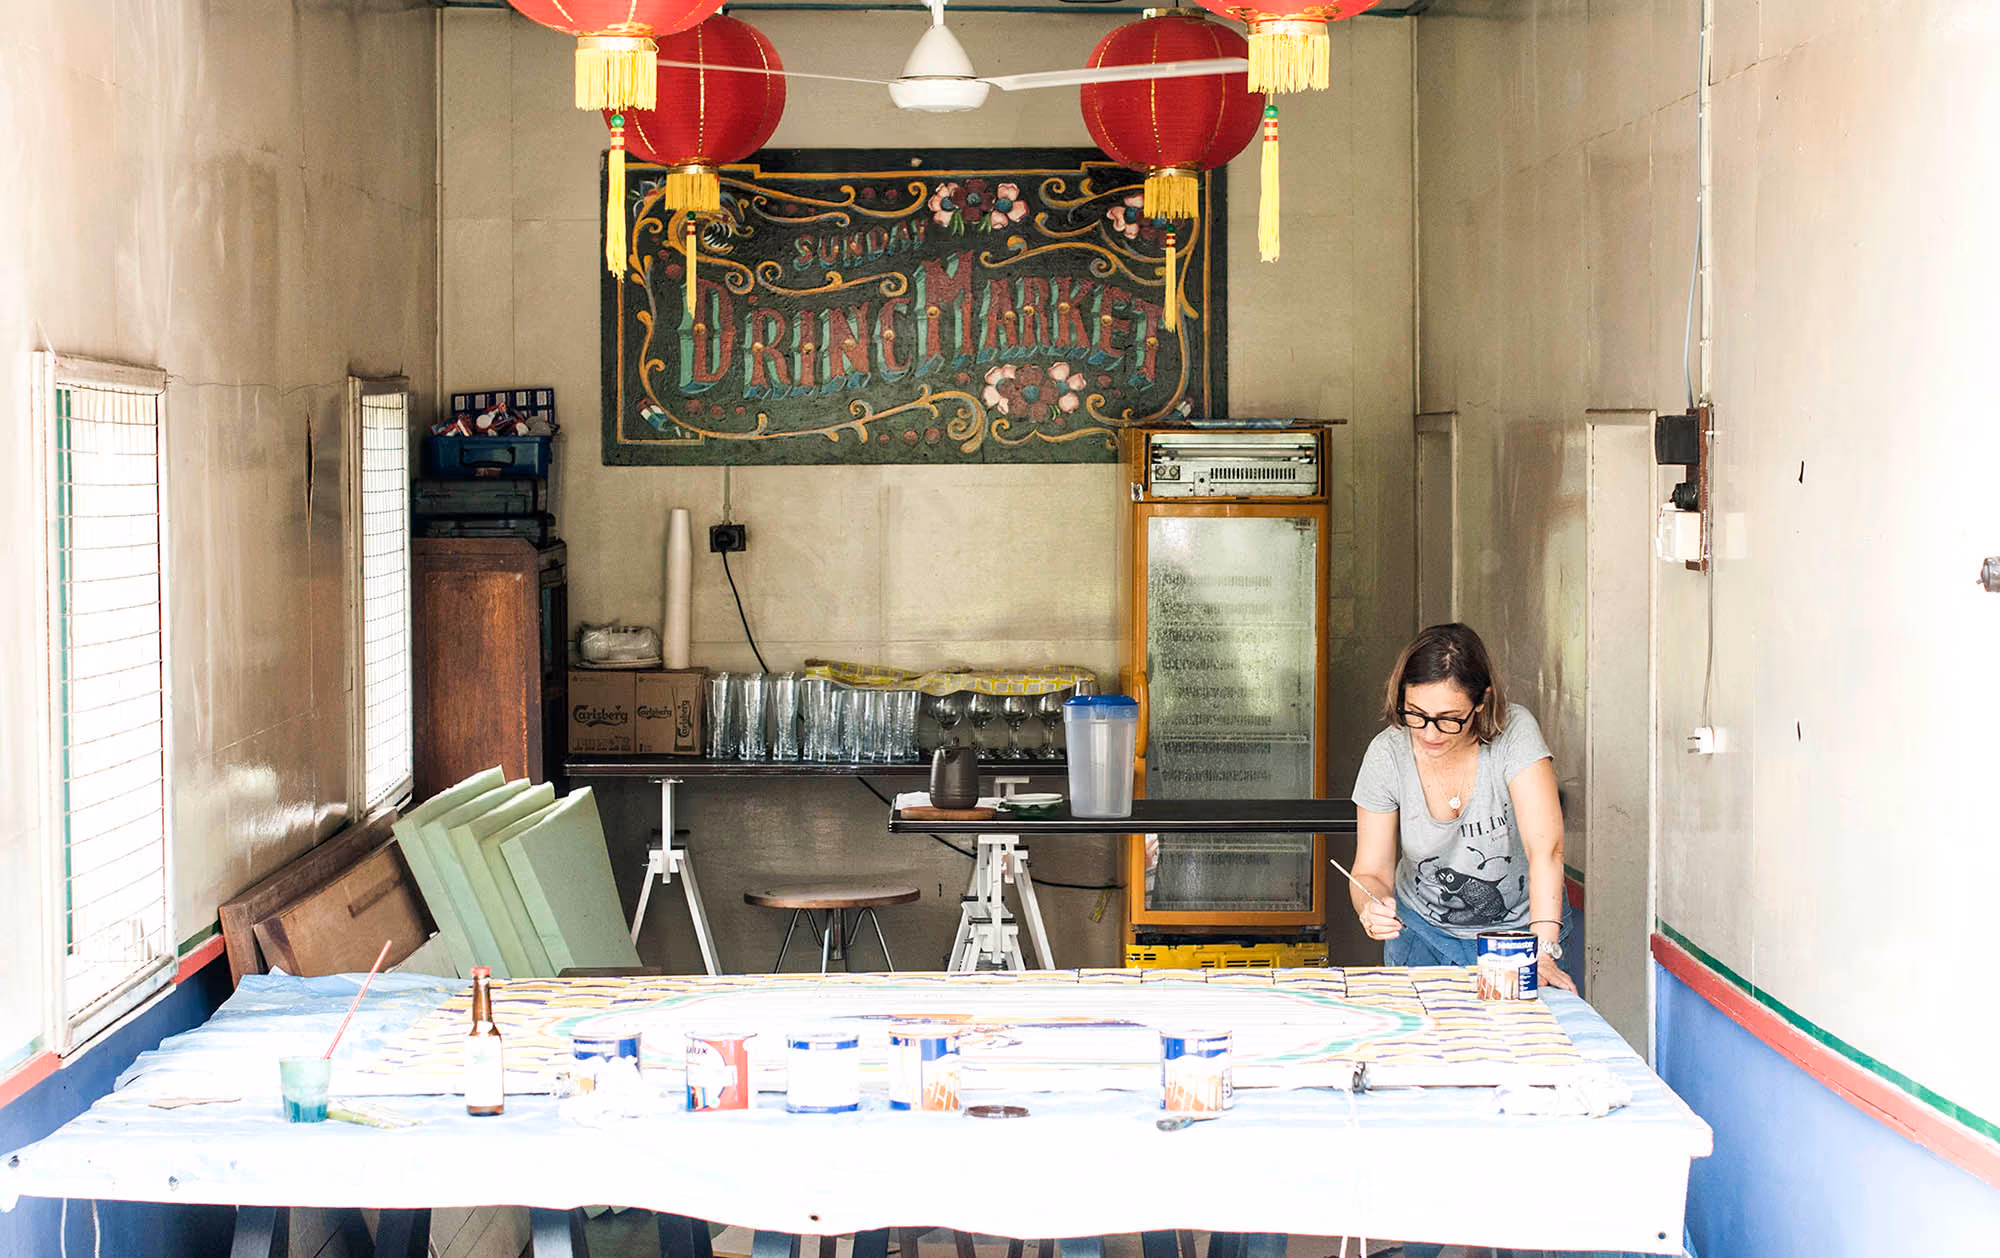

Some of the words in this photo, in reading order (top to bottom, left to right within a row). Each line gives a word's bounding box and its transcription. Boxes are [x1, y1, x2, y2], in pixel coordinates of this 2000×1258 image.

[793, 217, 929, 272] SUNDAY
[914, 249, 1168, 392] MARKET
[572, 704, 629, 725] Carlsberg
[637, 705, 673, 719] Carlsberg
[677, 700, 690, 738] Carlsberg
